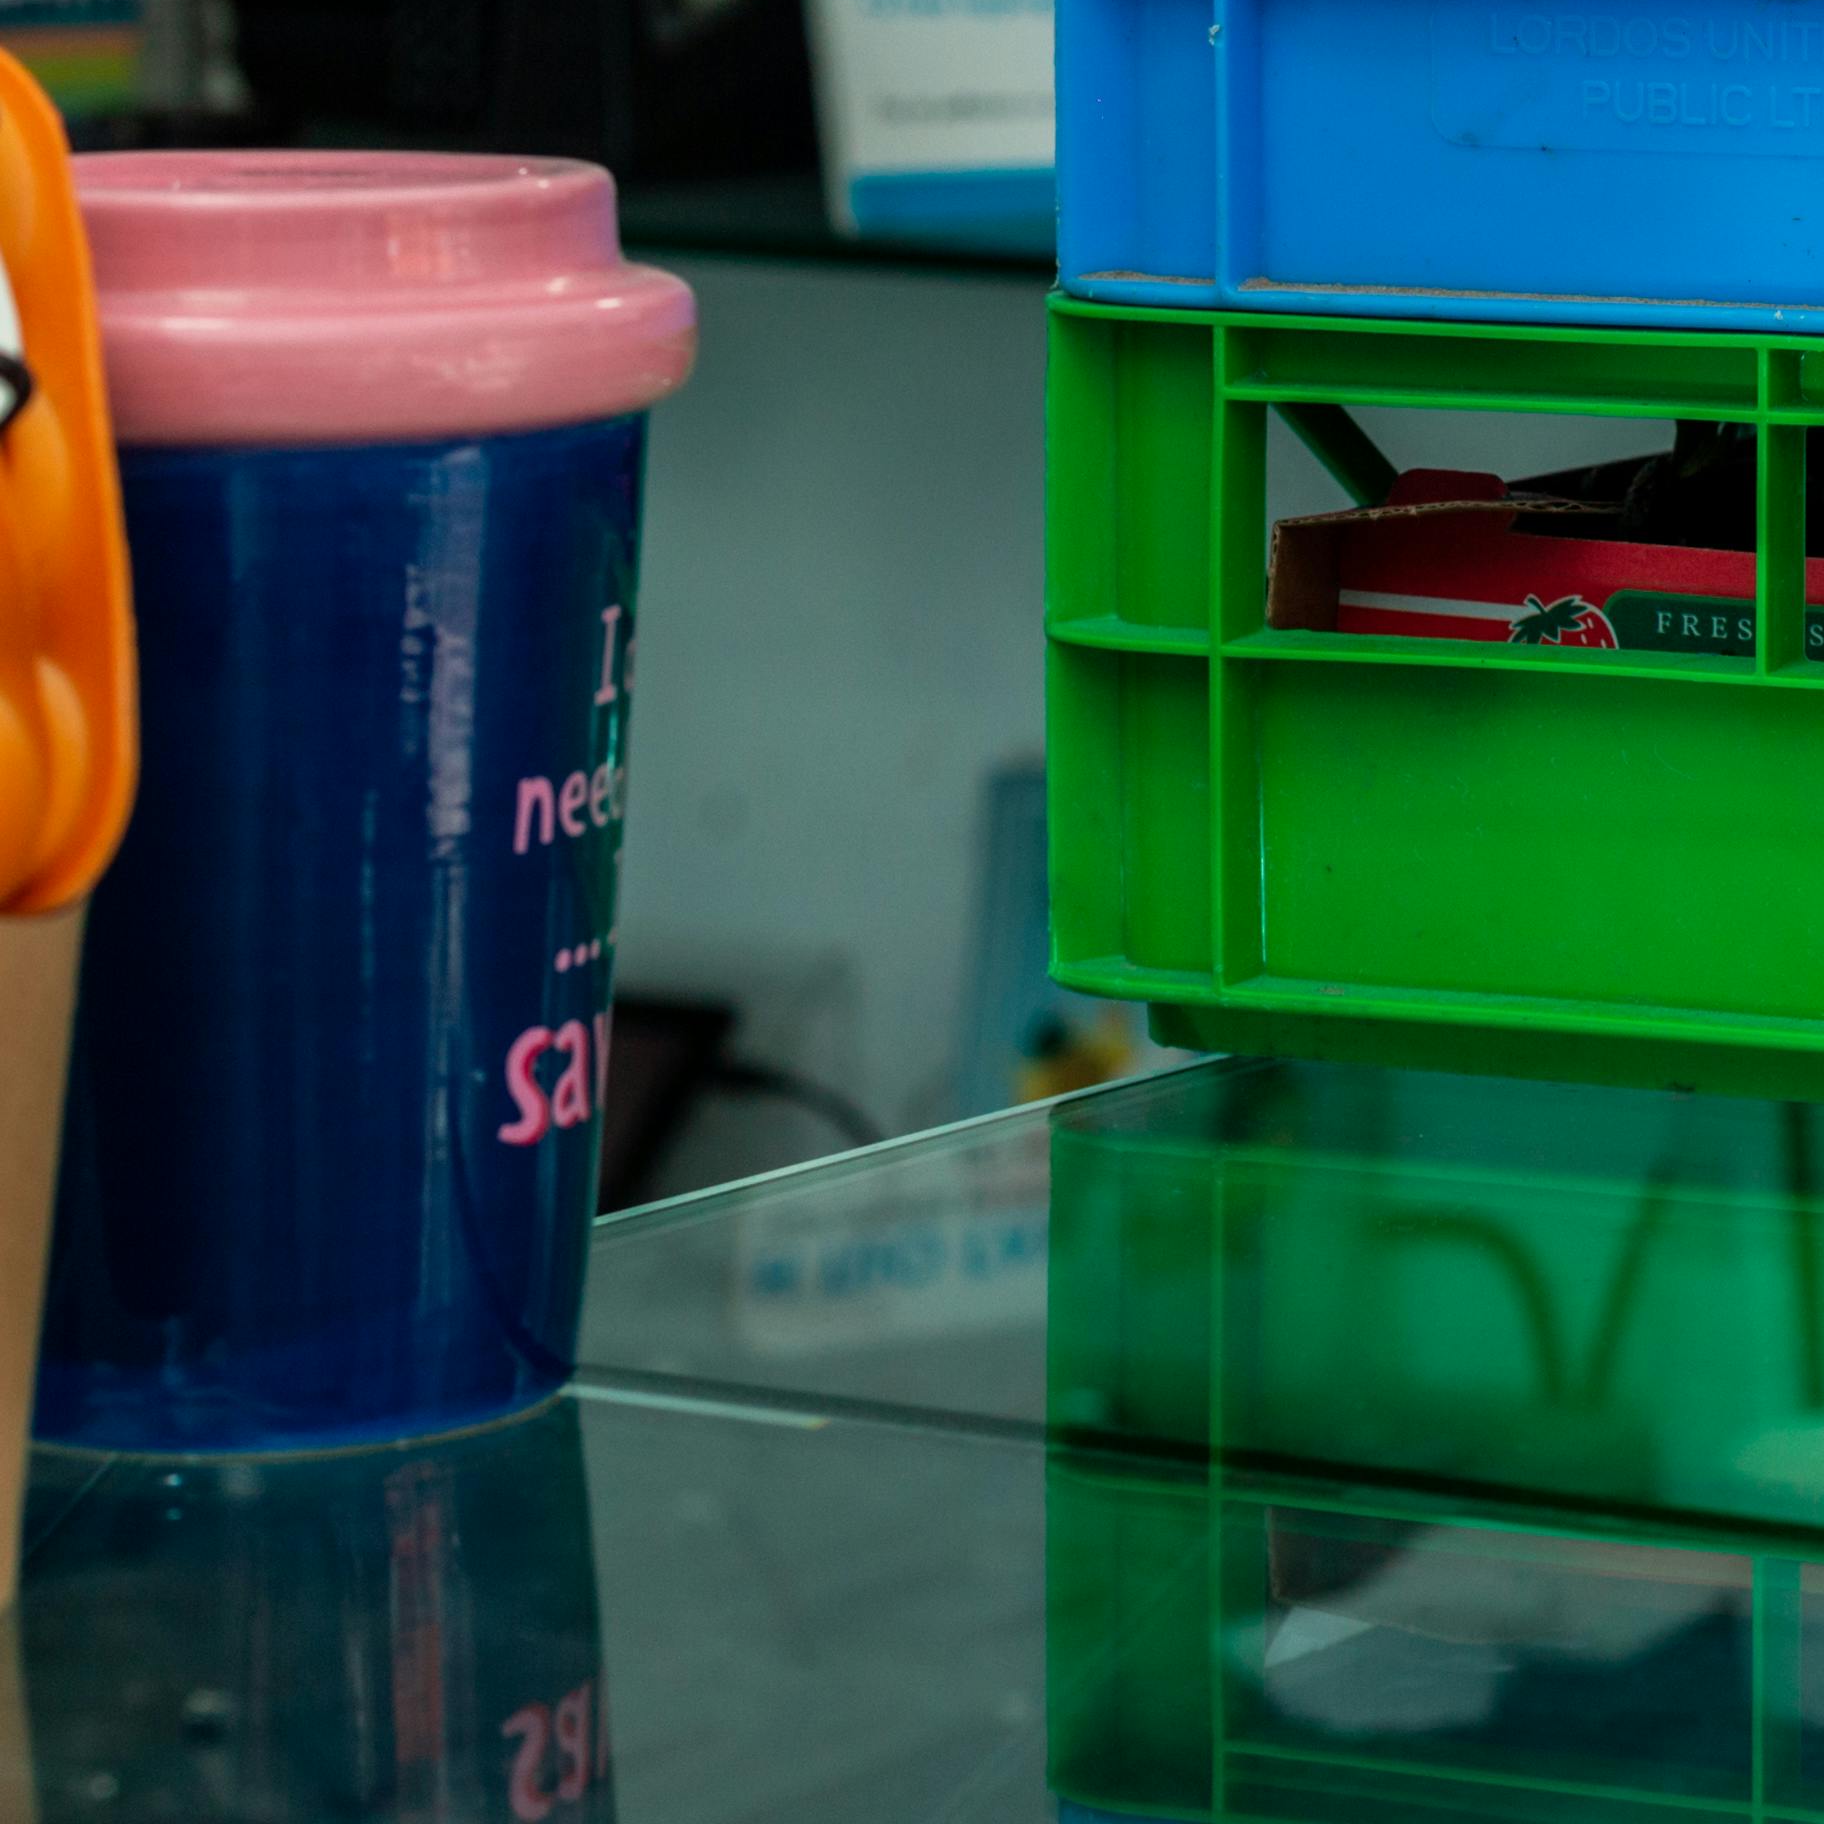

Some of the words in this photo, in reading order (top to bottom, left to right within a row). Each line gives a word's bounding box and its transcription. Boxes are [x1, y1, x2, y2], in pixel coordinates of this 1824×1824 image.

[1489, 12, 1693, 60] LORDOS
[1580, 79, 1753, 127] PUBLIC
[1656, 611, 1753, 641] FRES
